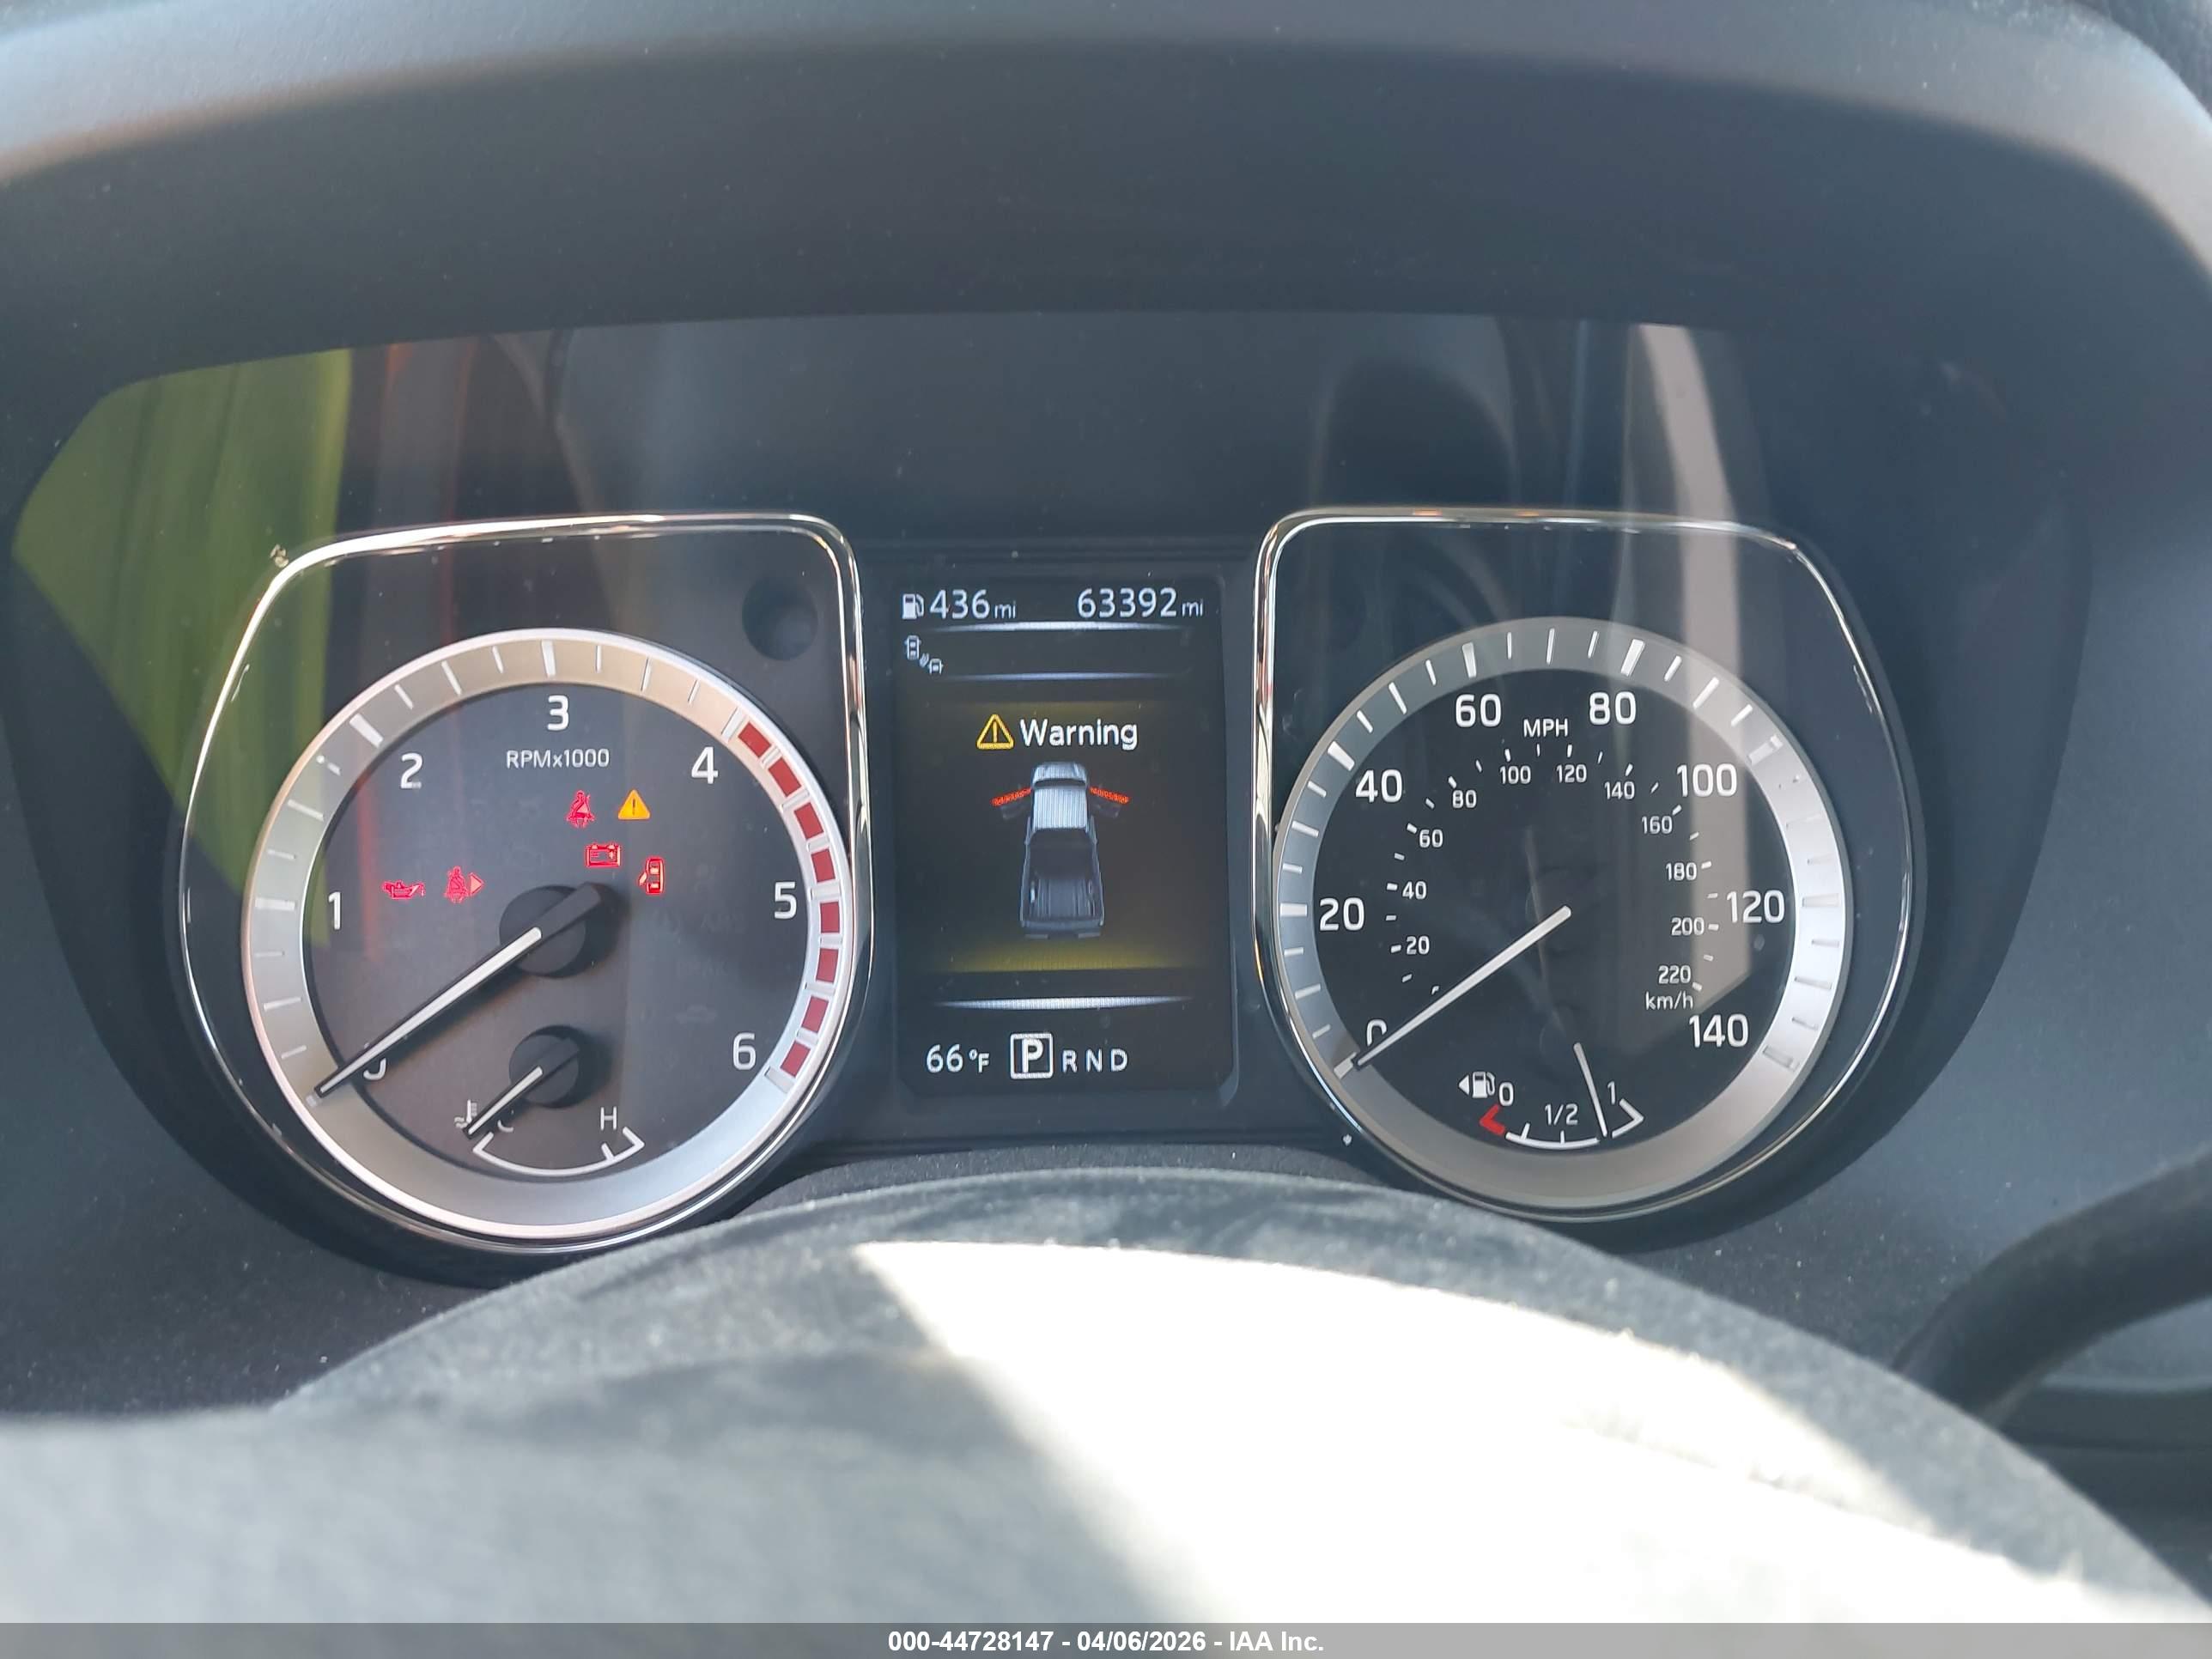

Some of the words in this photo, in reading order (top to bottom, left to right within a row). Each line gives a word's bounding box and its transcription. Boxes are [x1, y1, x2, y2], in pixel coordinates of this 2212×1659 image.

[547, 695, 569, 731] 3
[1455, 693, 1502, 727] 60
[1589, 691, 1637, 725] 80
[1019, 718, 1138, 750] Warning
[1523, 718, 1568, 738] MPH
[400, 752, 422, 789] 2
[506, 748, 610, 769] RPMx1000
[691, 746, 719, 785] 4
[1499, 765, 1531, 784] 100
[1556, 764, 1587, 783] 120
[1677, 763, 1737, 797] 100
[1355, 769, 1402, 803] 40
[1604, 781, 1635, 799] 140
[1452, 789, 1477, 809] 80
[1641, 815, 1673, 835] 160
[1419, 829, 1443, 848] 60
[1665, 862, 1698, 881] 180
[774, 881, 797, 920] 5
[1402, 881, 1427, 900] 40
[328, 891, 341, 930] 1
[1319, 897, 1364, 931] 20
[1726, 890, 1785, 924] 120
[1671, 916, 1705, 936] 200
[1406, 935, 1430, 955] 20
[1658, 964, 1691, 985] 220
[1645, 991, 1693, 1011] km/h
[1689, 1013, 1749, 1048] 140
[732, 1032, 757, 1071] 6
[1021, 1037, 1044, 1073] P
[1062, 1049, 1078, 1073] R
[1085, 1048, 1103, 1073] N
[1110, 1048, 1127, 1072] D
[1498, 1082, 1514, 1106] 0
[1607, 1081, 1616, 1104] 1
[600, 1106, 617, 1131] H
[1545, 1103, 1578, 1125] 1/2
